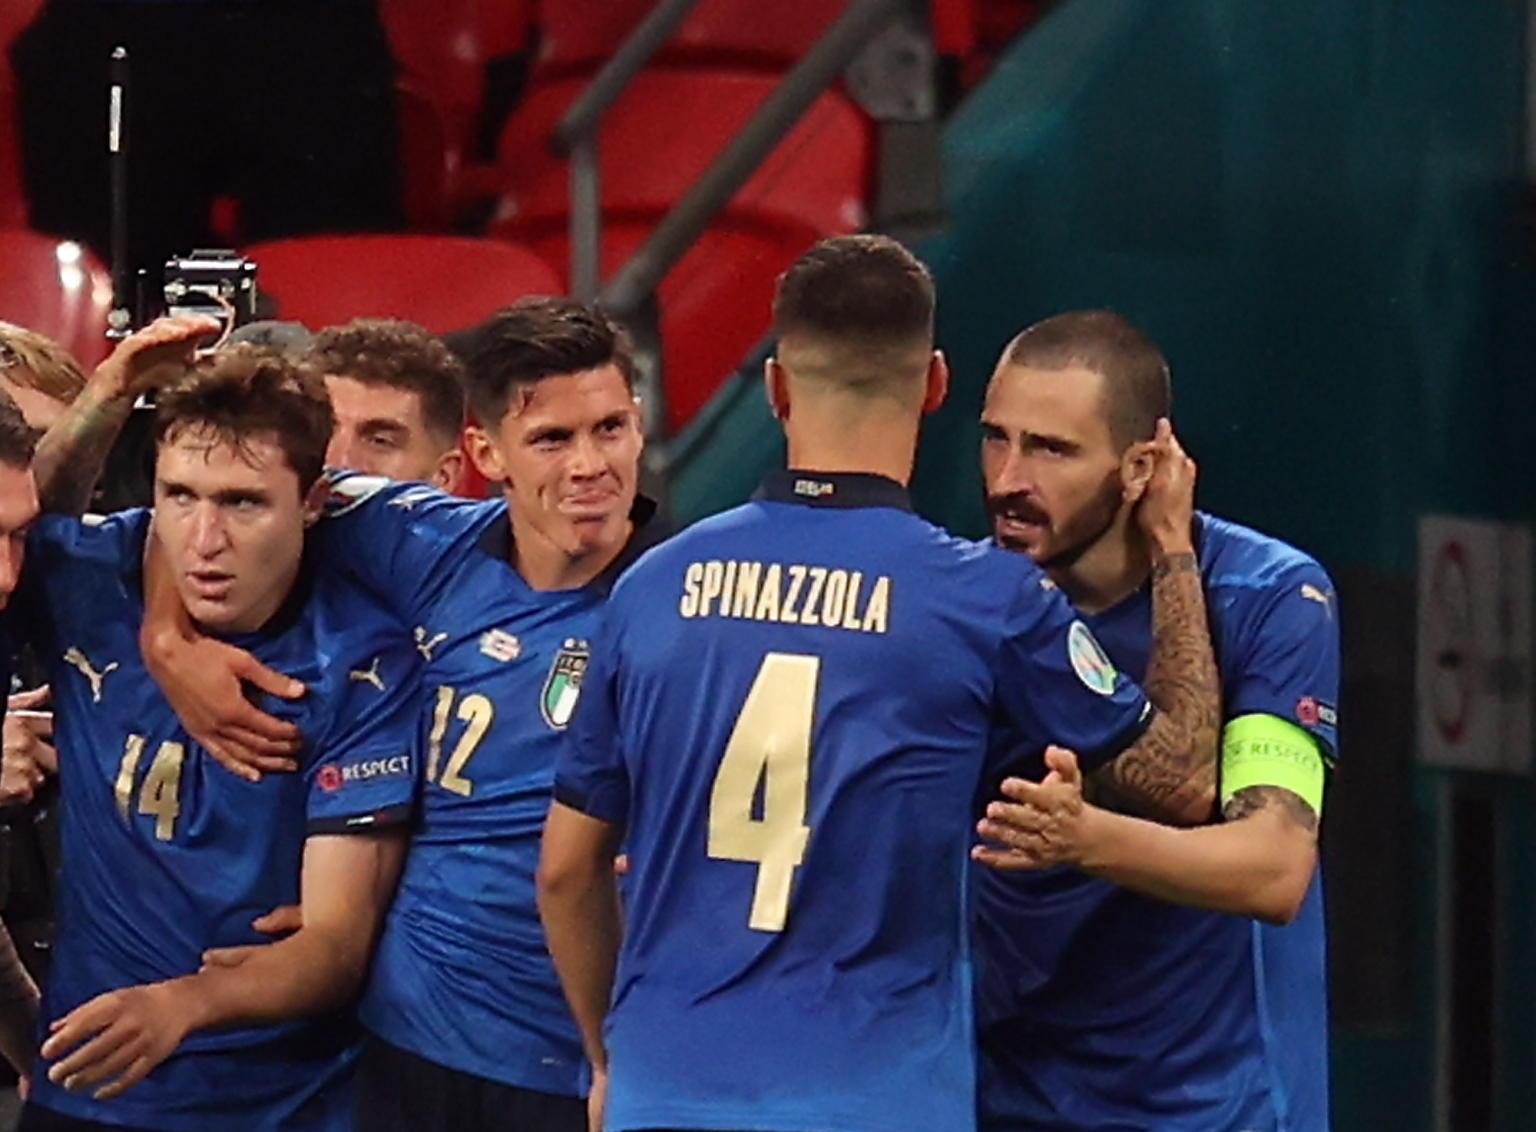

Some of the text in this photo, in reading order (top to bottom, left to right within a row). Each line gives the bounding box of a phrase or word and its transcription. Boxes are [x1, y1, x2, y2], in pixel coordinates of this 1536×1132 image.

[679, 559, 890, 634] SPINAZZOLA
[114, 733, 184, 841] 14
[341, 755, 410, 781] RESPECT
[425, 684, 493, 797] 12
[707, 652, 820, 931] 4
